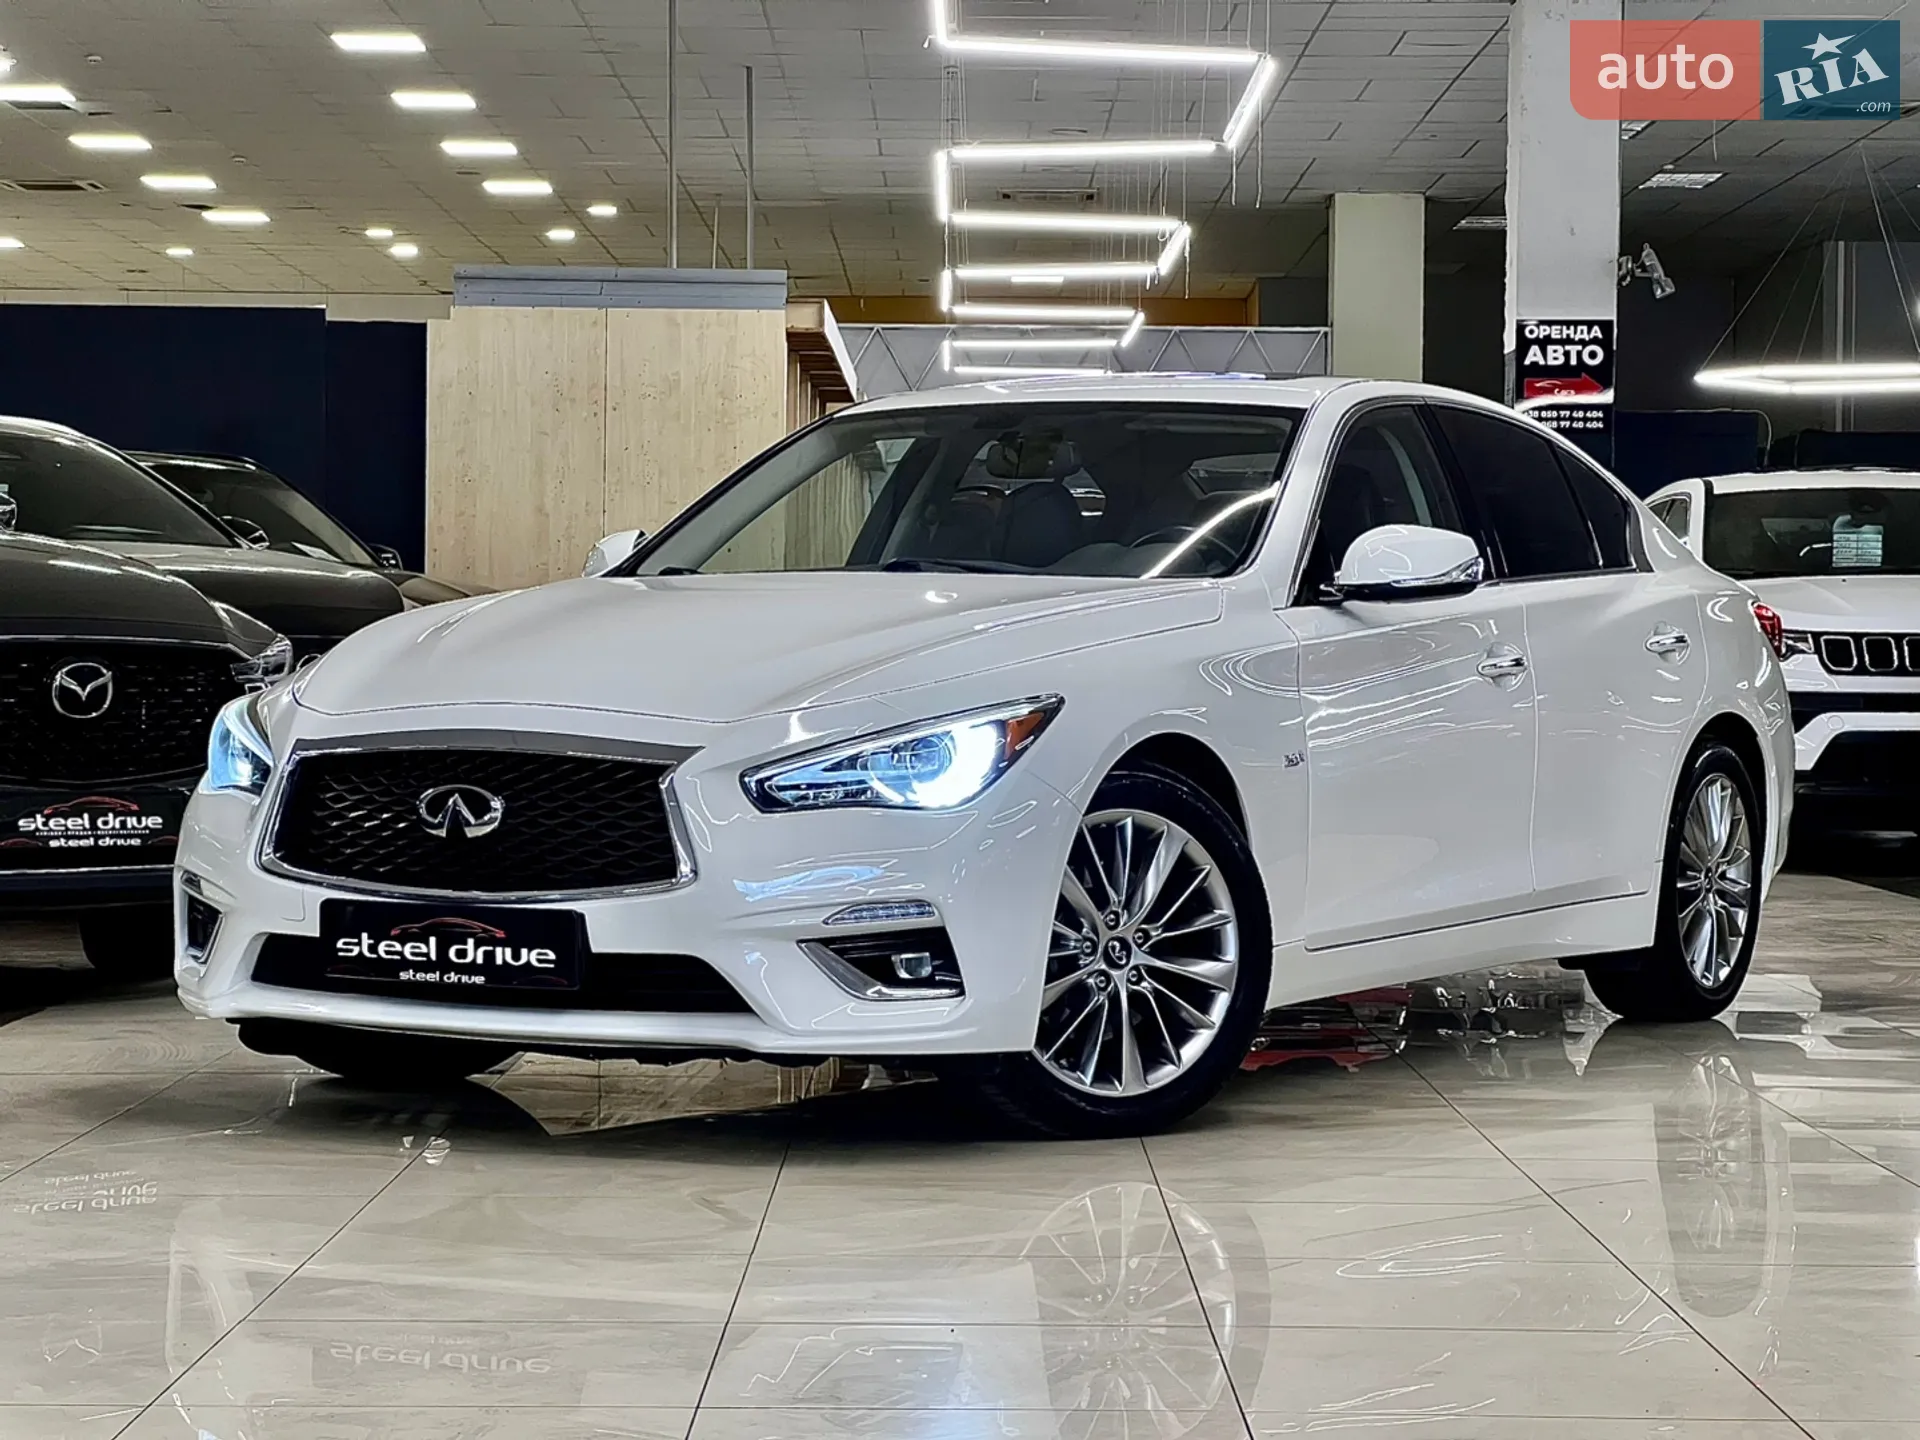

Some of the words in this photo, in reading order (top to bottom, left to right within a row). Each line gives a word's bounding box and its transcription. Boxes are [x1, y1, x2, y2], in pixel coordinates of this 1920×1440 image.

[1524, 325, 1603, 341] ОРЕНДА
[1523, 344, 1605, 366] АВТО
[1559, 410, 1571, 418] 77
[1572, 410, 1584, 418] 40
[1585, 410, 1604, 418] 404
[18, 813, 90, 831] steel
[96, 813, 163, 830] drive
[49, 837, 94, 847] steel
[98, 837, 141, 847] drive
[336, 932, 437, 961] steel
[448, 938, 556, 968] drive
[399, 969, 440, 982] steel
[443, 971, 486, 984] drive
